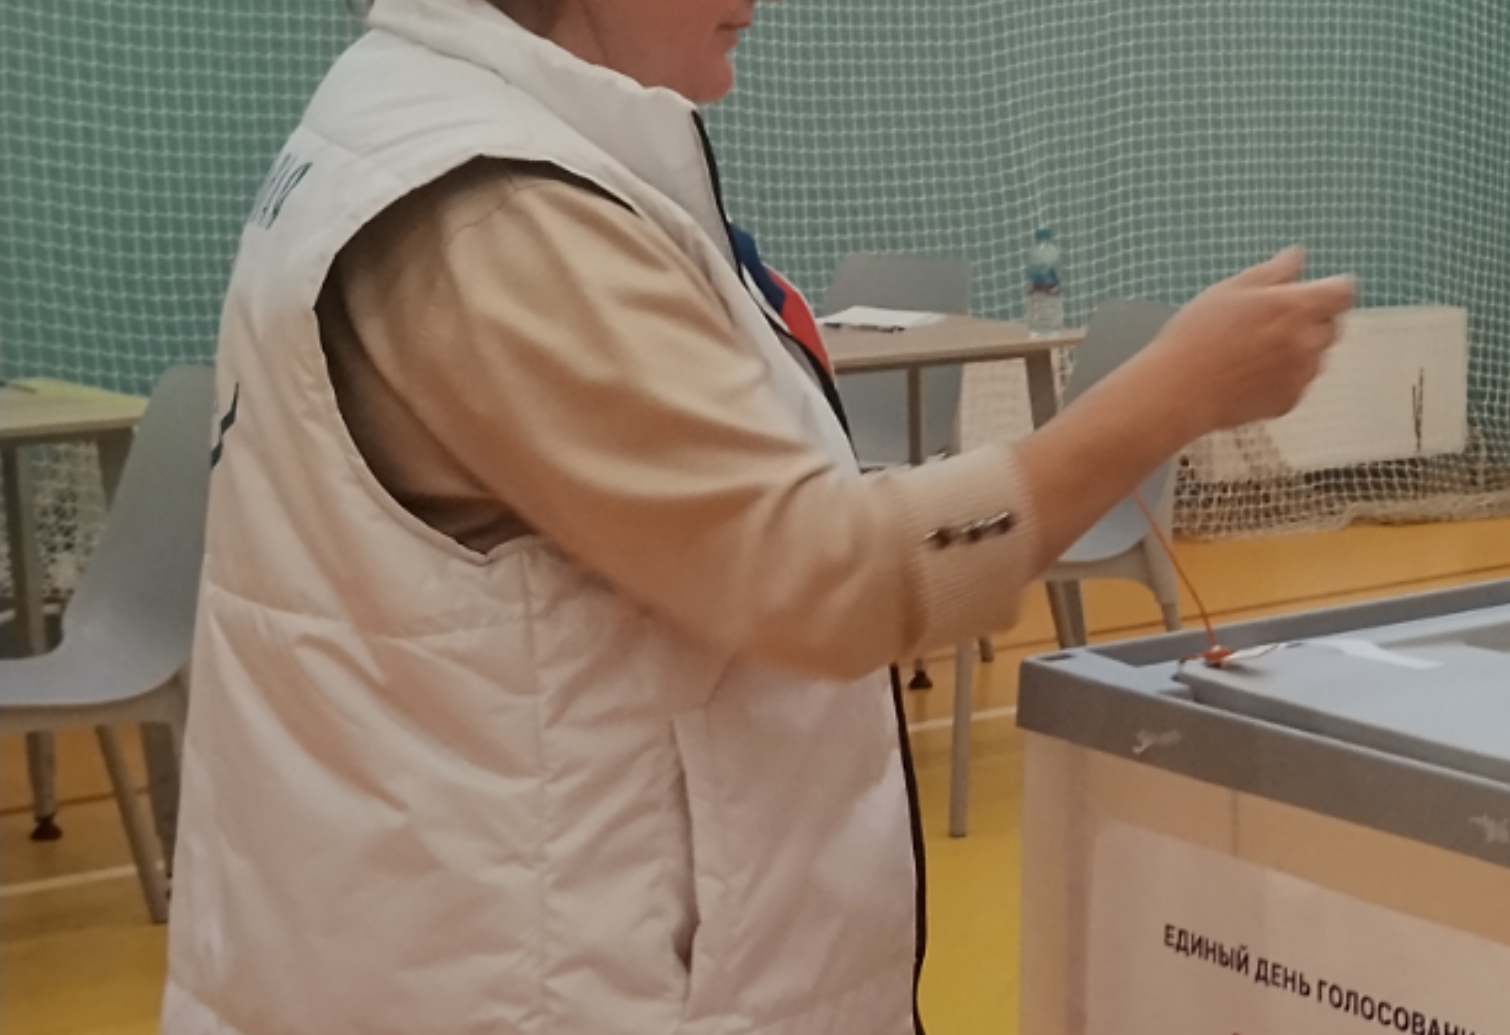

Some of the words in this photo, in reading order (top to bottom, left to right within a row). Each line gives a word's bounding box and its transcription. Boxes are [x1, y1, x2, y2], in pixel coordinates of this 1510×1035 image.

[1164, 922, 1250, 977] ЕДИНЫЙ
[1254, 957, 1312, 998] ДЕНЬ
[1316, 978, 1488, 1035] ГОЛОСОВАН
